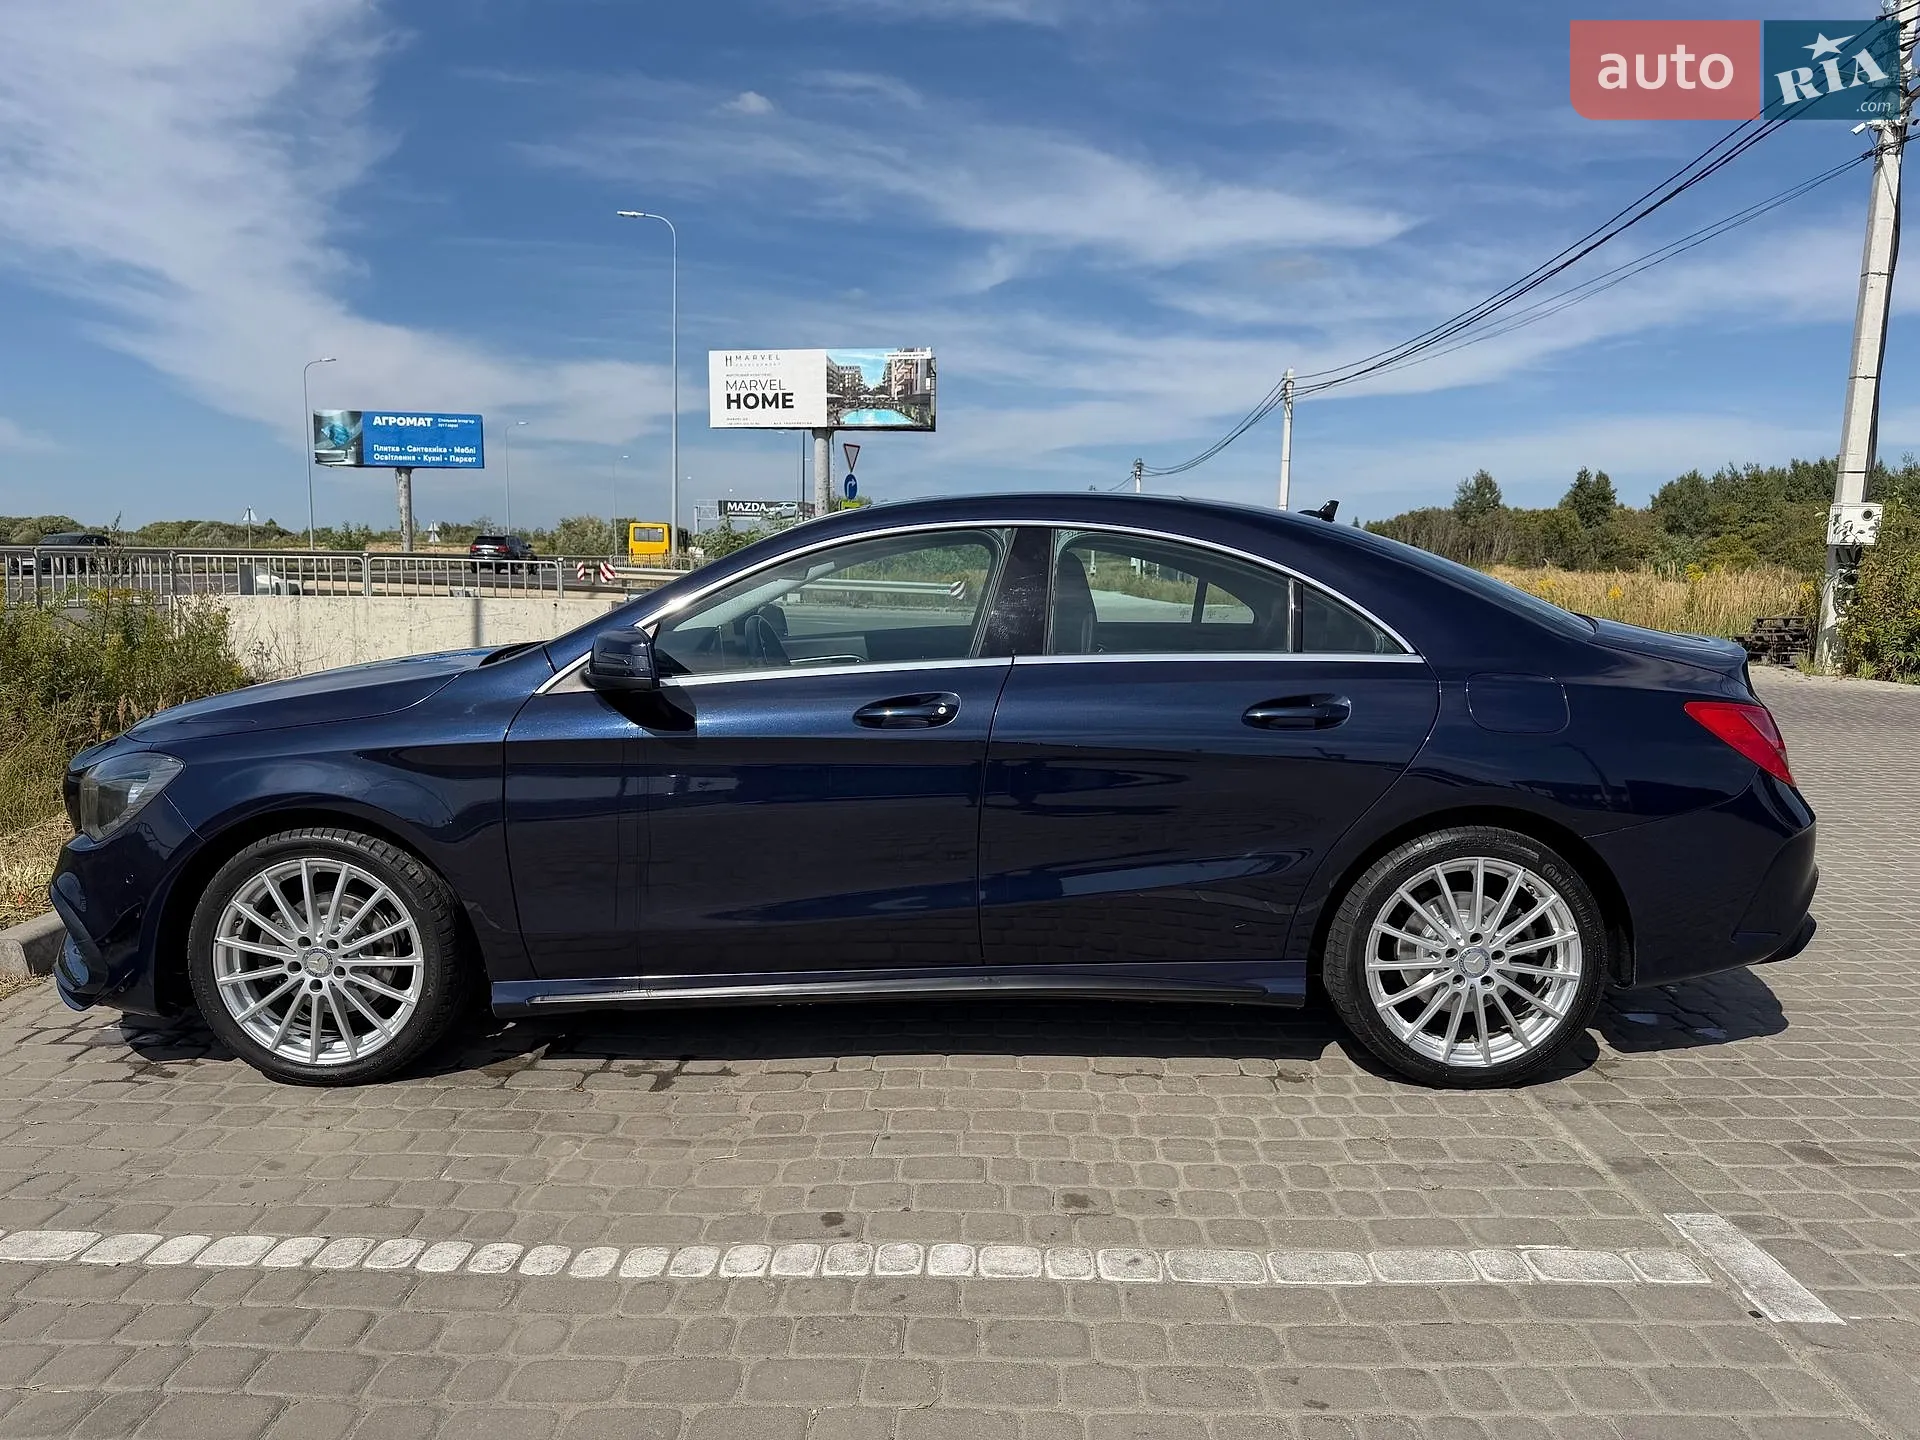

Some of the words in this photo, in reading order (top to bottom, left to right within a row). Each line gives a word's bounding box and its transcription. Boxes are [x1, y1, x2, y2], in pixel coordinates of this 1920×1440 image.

[726, 379, 786, 391] MARVEL
[726, 392, 794, 410] HOME
[373, 416, 433, 427] АГРОМАТ
[373, 444, 400, 452] Плитка
[454, 446, 476, 454] Меблі
[423, 454, 443, 463] Кухні
[449, 455, 477, 464] Паркет
[727, 502, 767, 512] MAZDA
